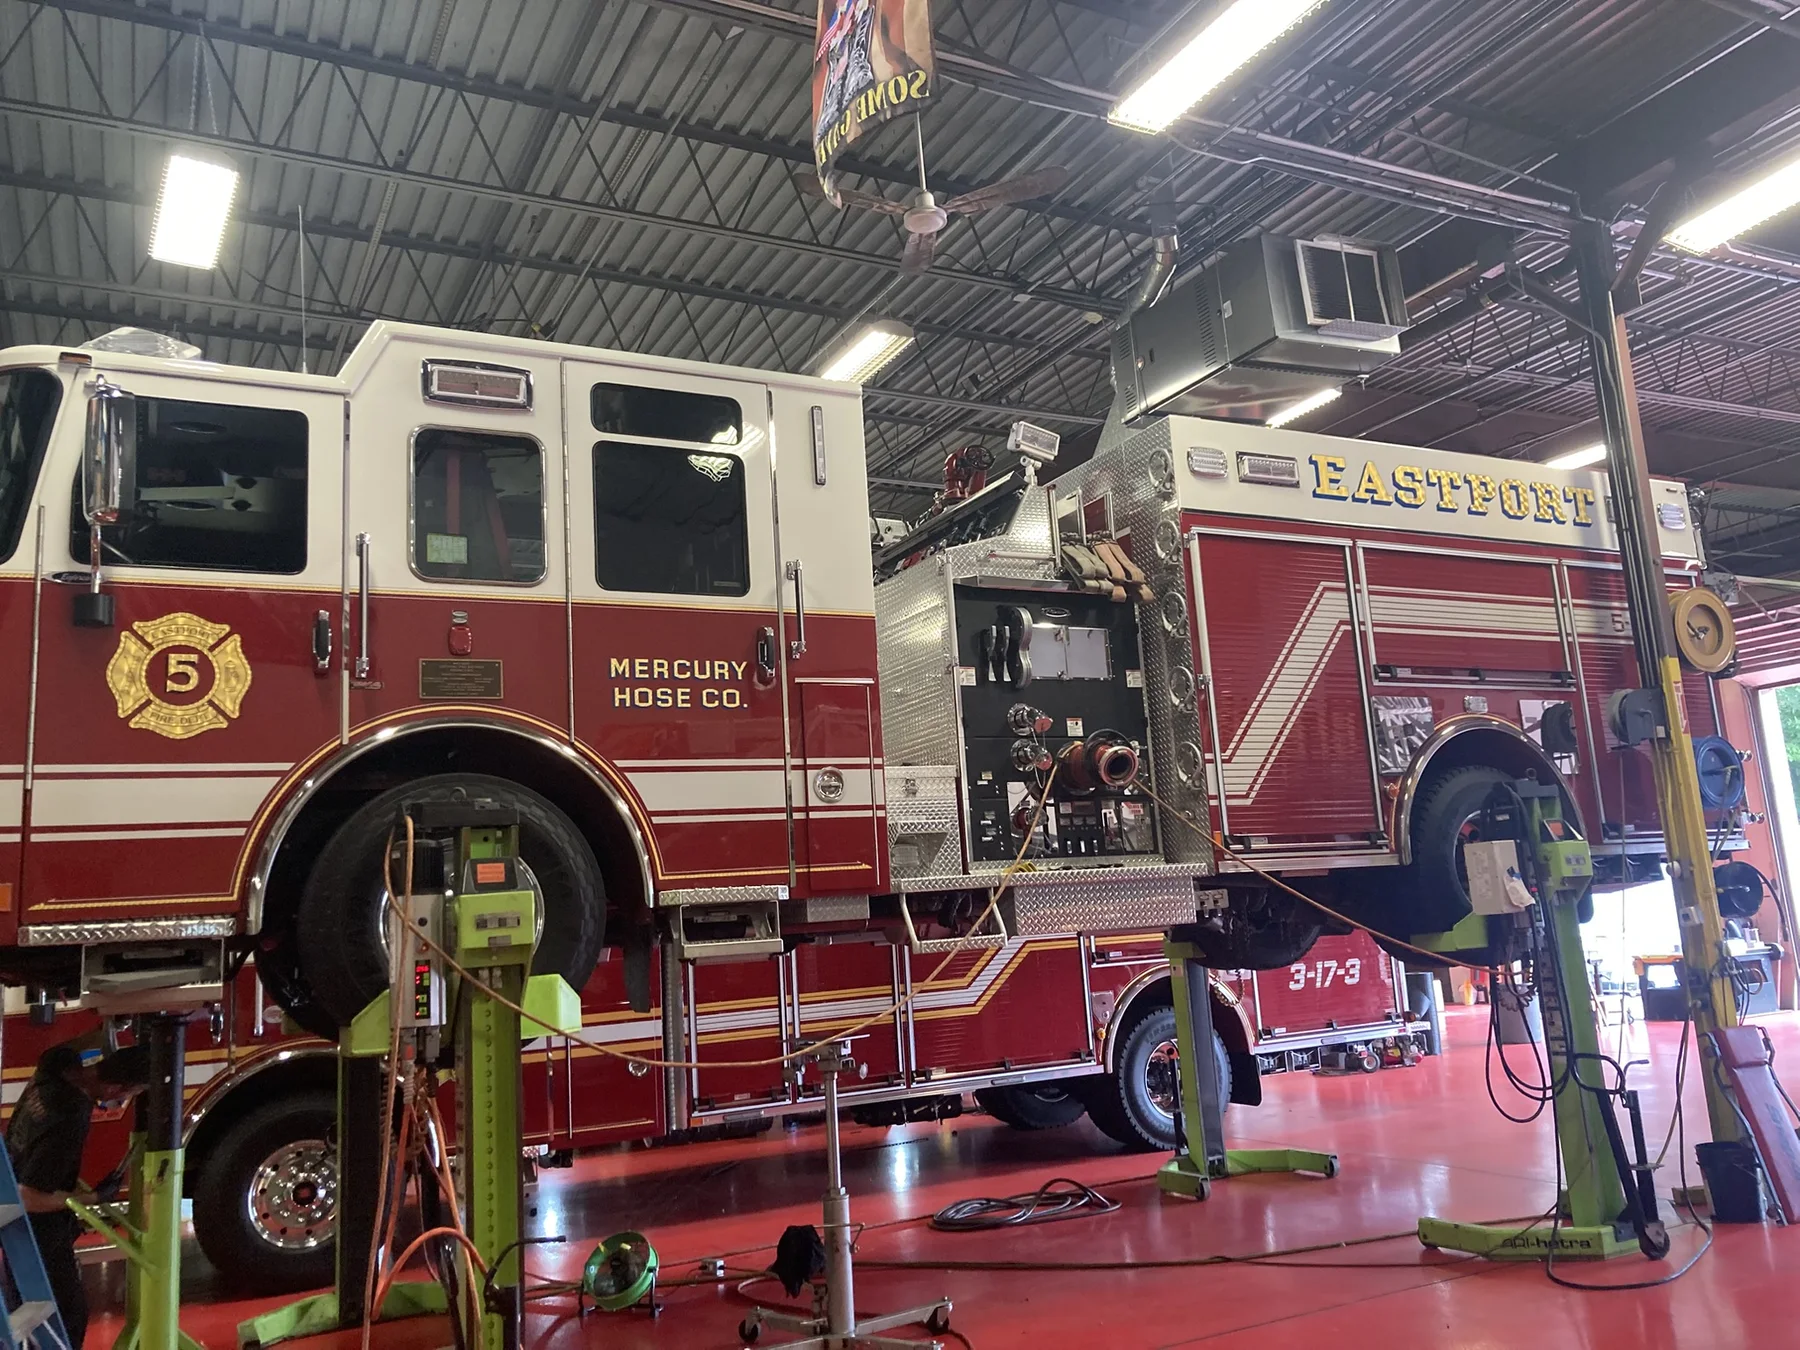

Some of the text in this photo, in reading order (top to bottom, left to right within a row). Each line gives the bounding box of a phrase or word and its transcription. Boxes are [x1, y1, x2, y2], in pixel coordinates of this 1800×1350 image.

[1309, 454, 1595, 527] EASTPORT
[166, 653, 199, 693] 5
[609, 657, 748, 681] MERCURY
[613, 686, 749, 709] HOSE CO.
[150, 711, 175, 724] FIRE
[1288, 957, 1361, 991] 3-17-3
